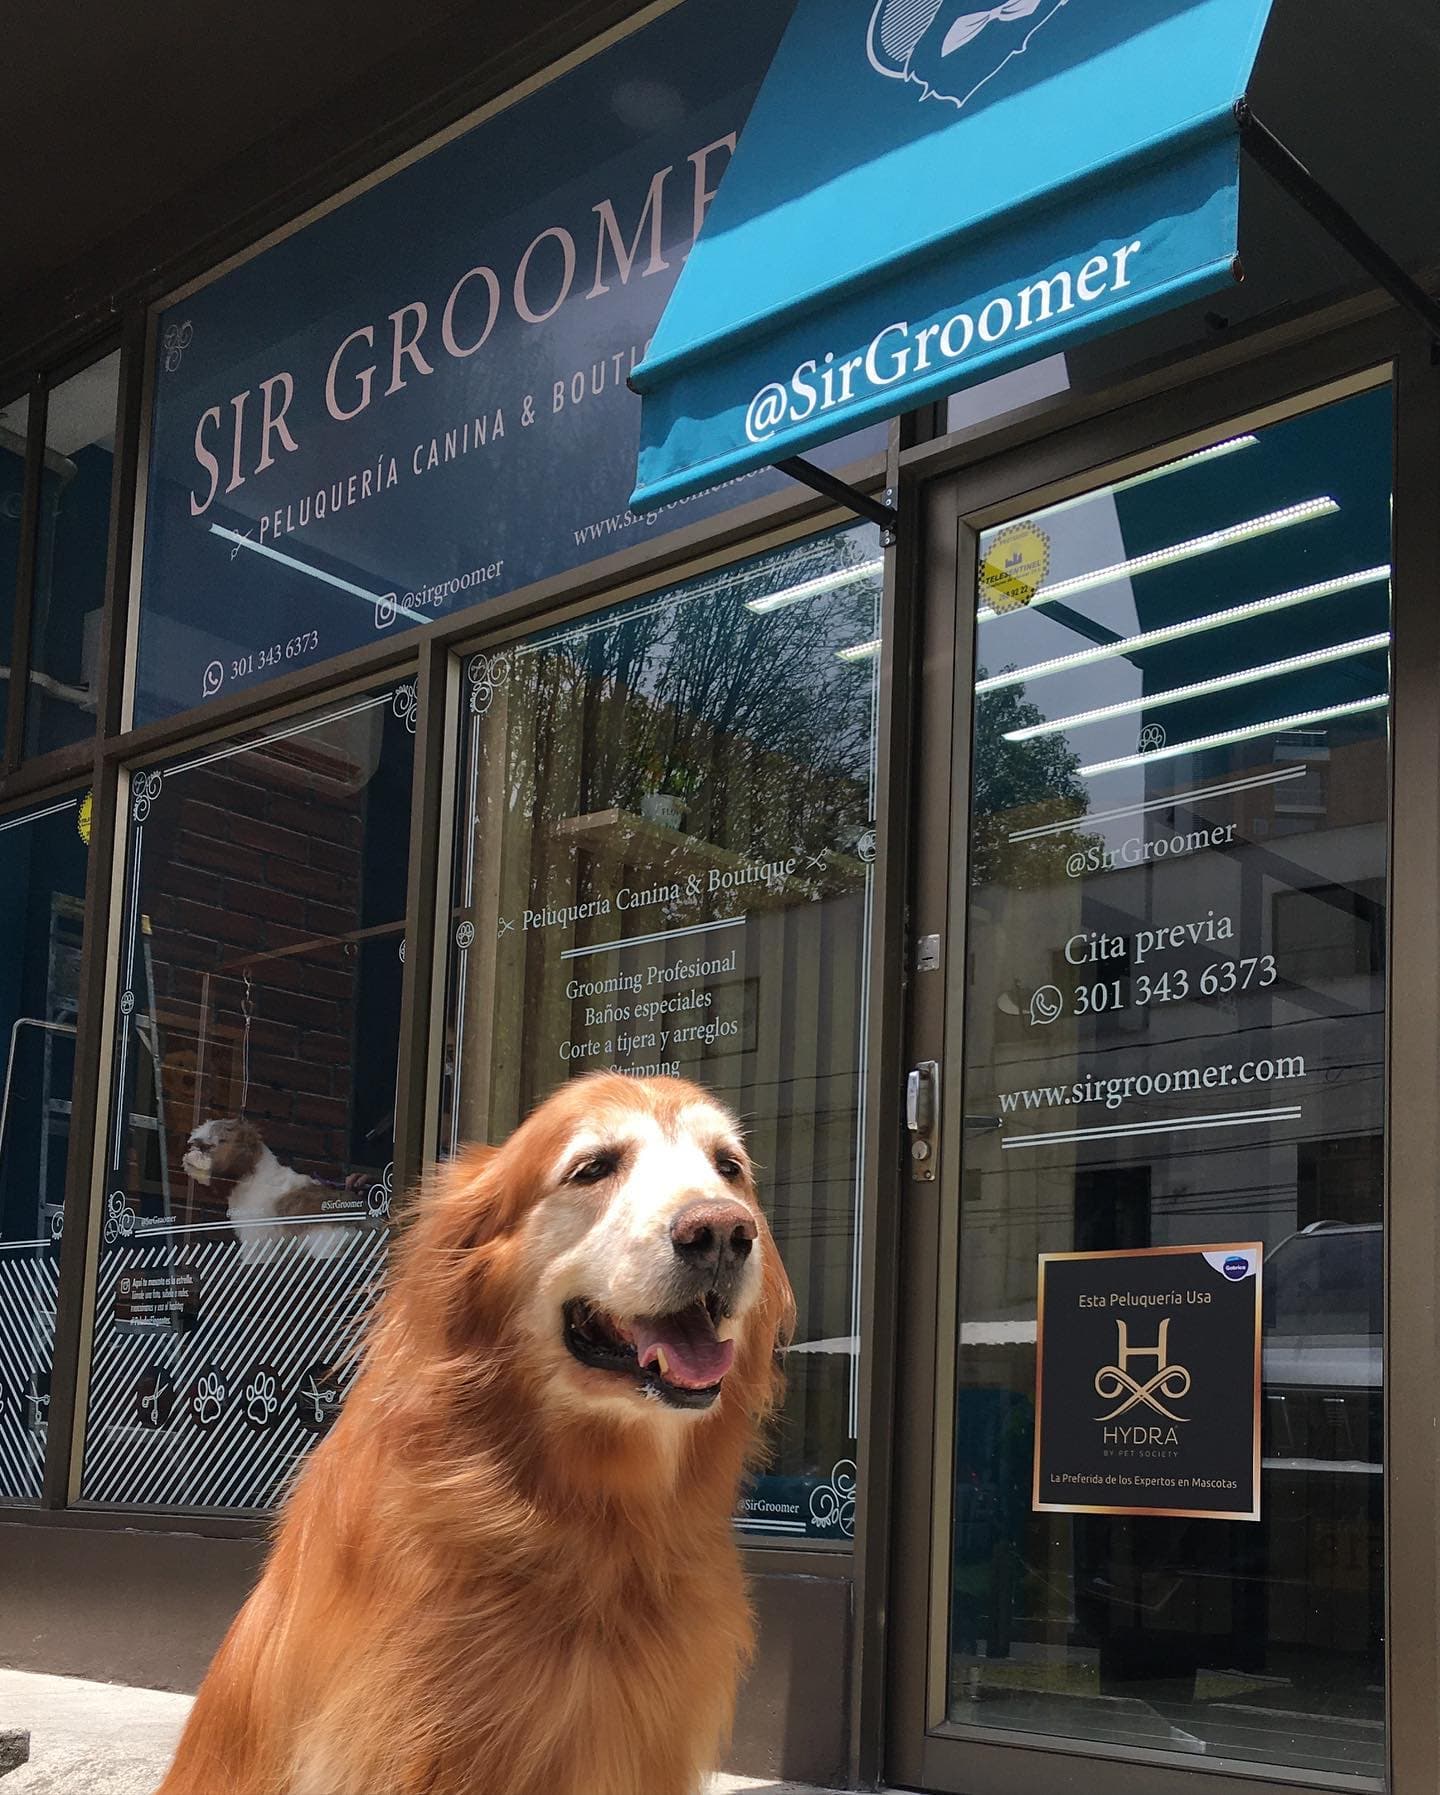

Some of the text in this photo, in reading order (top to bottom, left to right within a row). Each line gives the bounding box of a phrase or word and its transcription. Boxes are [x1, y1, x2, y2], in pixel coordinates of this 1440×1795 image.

[191, 130, 737, 516] SIR GROOME
[745, 240, 1141, 443] @SirGroomer
[260, 338, 651, 543] PELUQUERÍA CANINA & BOUTI
[400, 560, 504, 611] @sirgroomer
[230, 630, 319, 680] 301 343 6373
[1066, 823, 1237, 878] @SirGroomer
[616, 882, 679, 912] Canina
[685, 874, 701, 897] &
[708, 857, 796, 893] Boutique
[1065, 911, 1234, 965] Cita previa
[566, 950, 737, 1000] Grooming Profesional
[1073, 954, 1278, 1015] 301 343 6373
[584, 989, 712, 1027] Baños especiales
[559, 1017, 738, 1061] Corte a tijera y arreglos
[998, 1055, 1307, 1113] www.sirgroomer.com
[1079, 1290, 1211, 1308] Esta Peluquería Usa
[1103, 1426, 1178, 1445] HYDRA
[1139, 1450, 1179, 1458] SOCIETY
[1050, 1473, 1237, 1489] La Preferida de los Expertos en Mascotas
